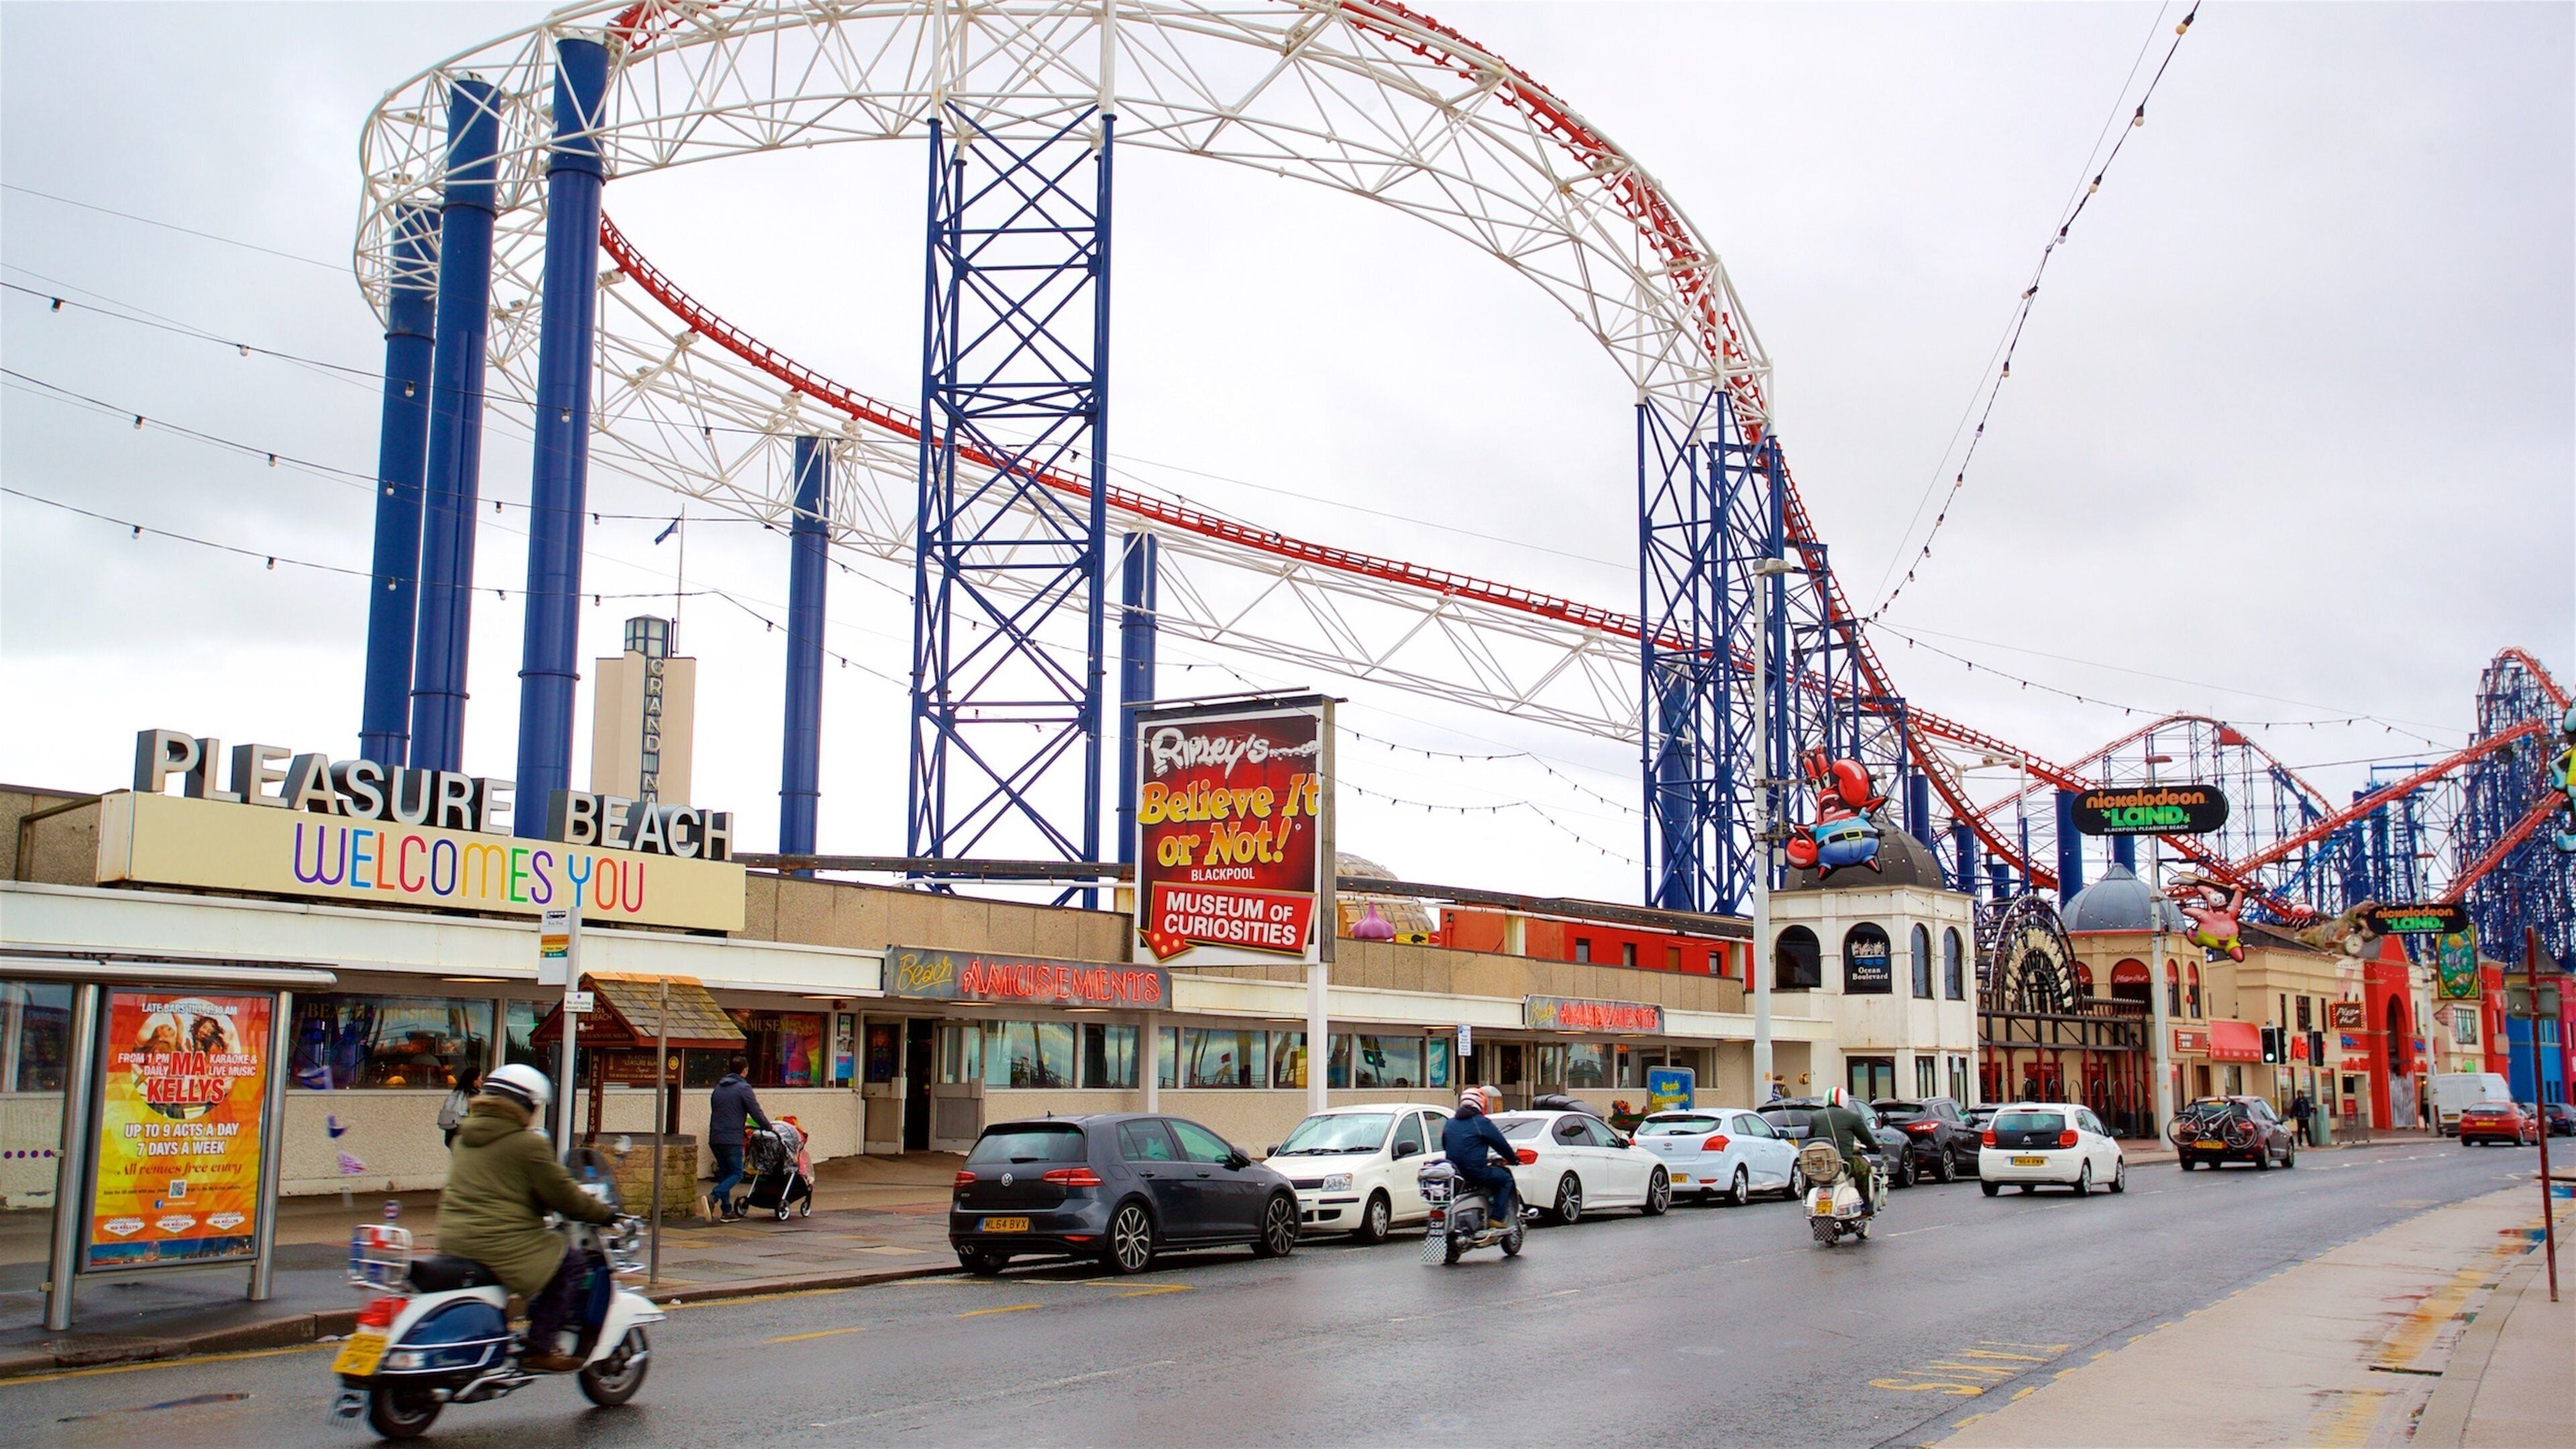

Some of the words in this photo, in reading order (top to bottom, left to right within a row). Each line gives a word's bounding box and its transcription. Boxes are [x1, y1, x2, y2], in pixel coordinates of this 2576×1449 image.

[1150, 727, 1270, 778] Ripley's
[136, 729, 515, 836] PLEASURE
[549, 790, 733, 861] BEACH
[1138, 779, 1274, 824] Believe
[1281, 773, 1320, 817] It
[2086, 789, 2206, 809] nickelodeon
[1157, 834, 1200, 867] or
[1203, 816, 1292, 866] Not!
[293, 822, 553, 905] WELCOMES
[568, 853, 645, 913] YOU
[1191, 867, 1255, 881] BLACKPOOL
[1166, 892, 1264, 920] MUSEUM
[1270, 904, 1293, 922] OF
[2375, 906, 2455, 918] nickelodeon
[1164, 914, 1297, 946] CURIOSITIES
[897, 953, 953, 991] Beach
[962, 959, 1161, 1003] AMUSEMENTS
[142, 1003, 162, 1013] LATE
[2336, 1007, 2360, 1016] Pizza
[1559, 1004, 1658, 1030] AMUSEMENTS
[2339, 1016, 2357, 1024] Hut
[118, 1053, 144, 1063] FROM
[147, 1054, 152, 1063] 1
[156, 1054, 170, 1063] PM
[171, 1052, 206, 1076] MA
[210, 1055, 249, 1064] KARAOKE
[250, 1055, 258, 1063] &
[144, 1065, 168, 1076] DAILY
[209, 1066, 227, 1076] LIVE
[228, 1066, 256, 1076] MUSIC
[146, 1077, 225, 1104] KELLYS
[1661, 1080, 1680, 1091] Beach
[125, 1124, 142, 1138] UP
[146, 1124, 160, 1138] TO
[162, 1124, 170, 1137] 9
[172, 1123, 203, 1138] ACTS
[205, 1123, 214, 1136] A
[217, 1122, 239, 1136] DAY
[137, 1142, 144, 1156] 7
[148, 1142, 178, 1156] DAYS
[180, 1142, 189, 1155] A
[192, 1140, 226, 1155] WEEK
[182, 1163, 209, 1176] free
[211, 1163, 242, 1175] entry
[1009, 1219, 1027, 1229] BVX
